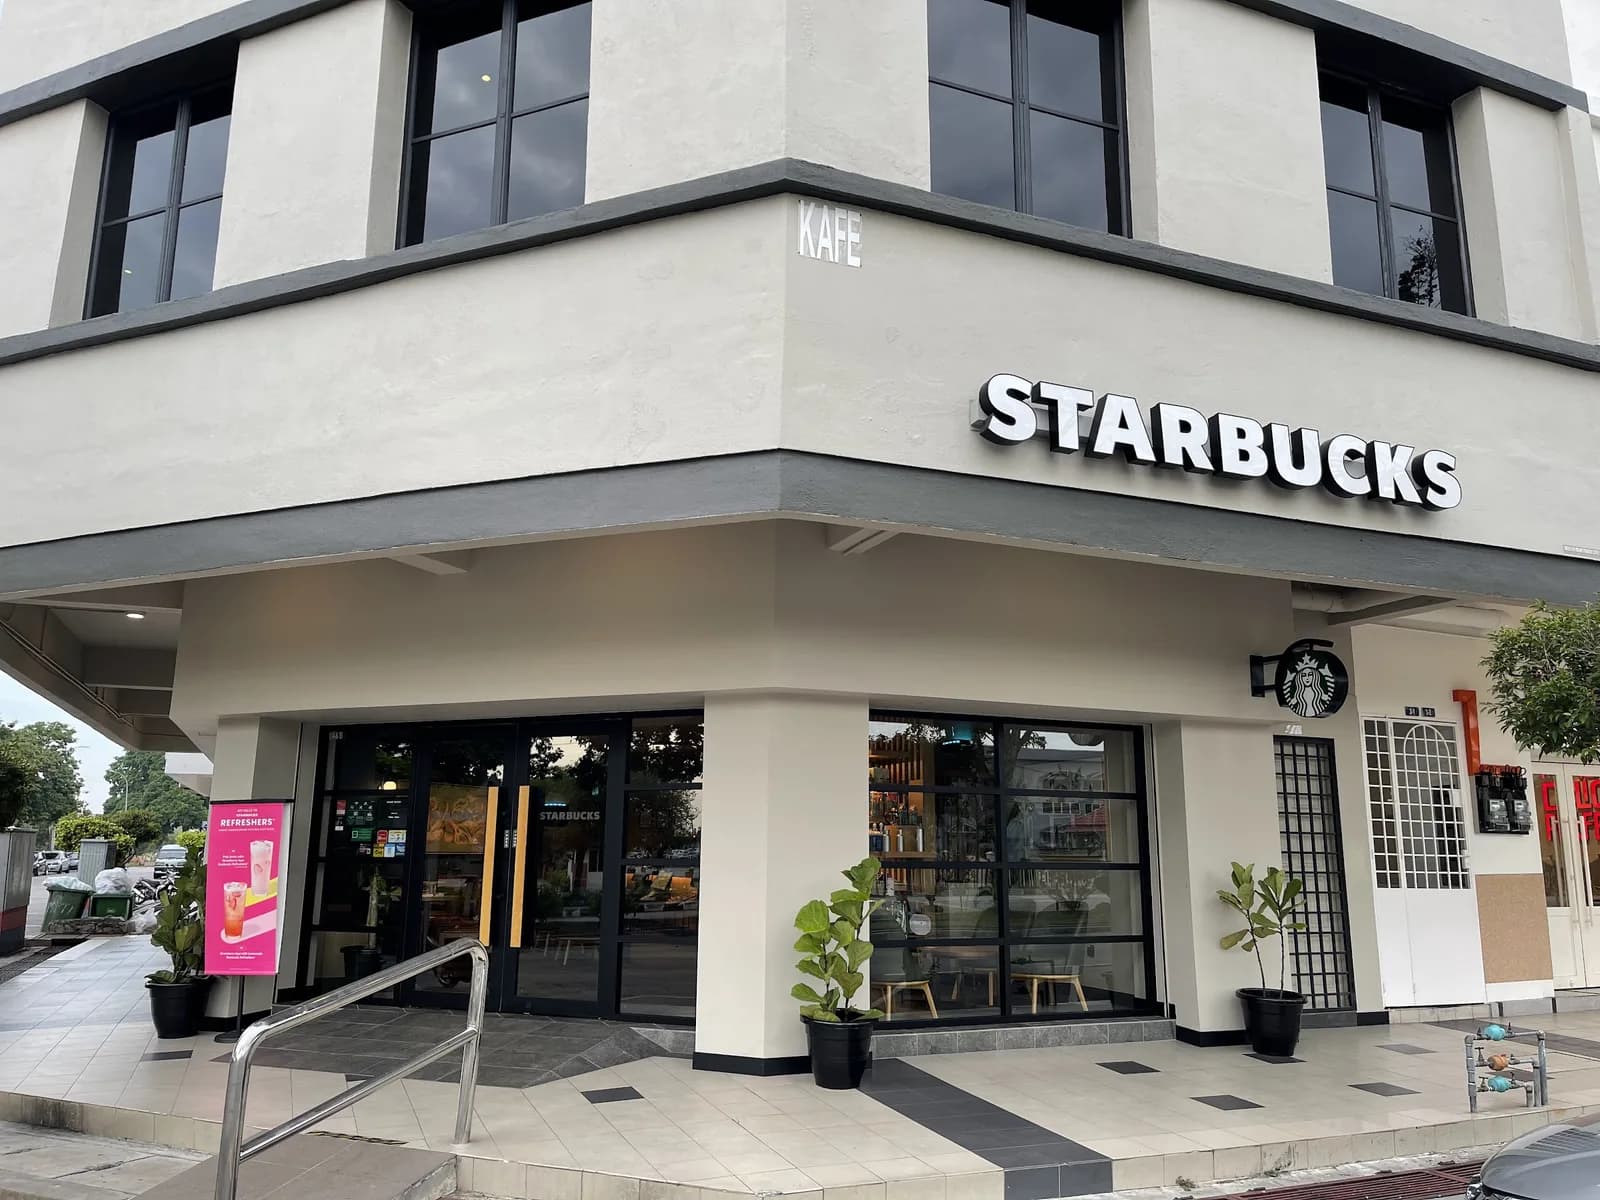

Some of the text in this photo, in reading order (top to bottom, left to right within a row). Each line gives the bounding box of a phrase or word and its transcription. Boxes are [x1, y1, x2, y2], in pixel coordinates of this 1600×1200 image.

[800, 200, 861, 268] KAFE
[979, 373, 1463, 511] STARBUCKS
[220, 818, 273, 827] REFRESHERS
[540, 811, 600, 820] STARBUCKS
